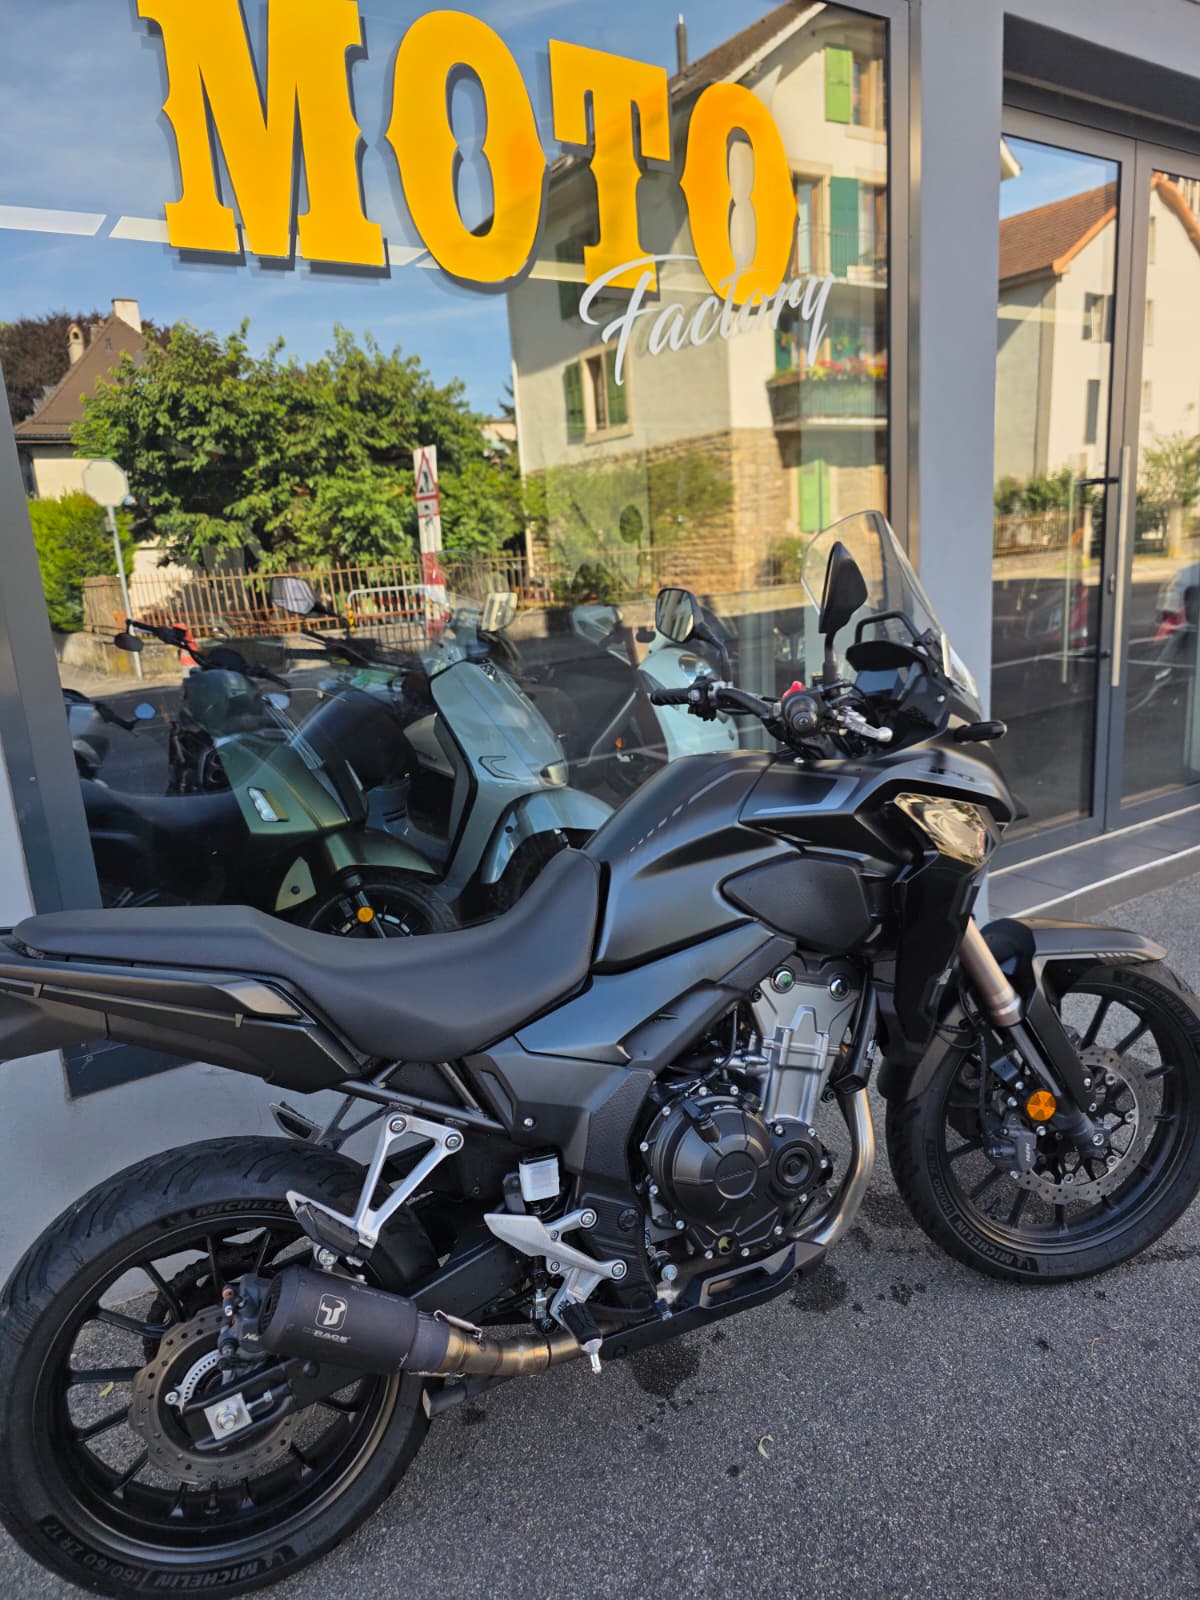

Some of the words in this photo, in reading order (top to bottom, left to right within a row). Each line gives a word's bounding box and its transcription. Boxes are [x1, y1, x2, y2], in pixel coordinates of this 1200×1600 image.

[137, 0, 798, 306] MOTO
[579, 254, 834, 386] Factory
[955, 1219, 1016, 1265] MICHELIN
[48, 1523, 64, 1540] 17
[62, 1536, 84, 1556] ZR
[154, 1561, 258, 1588] MICHELIN
